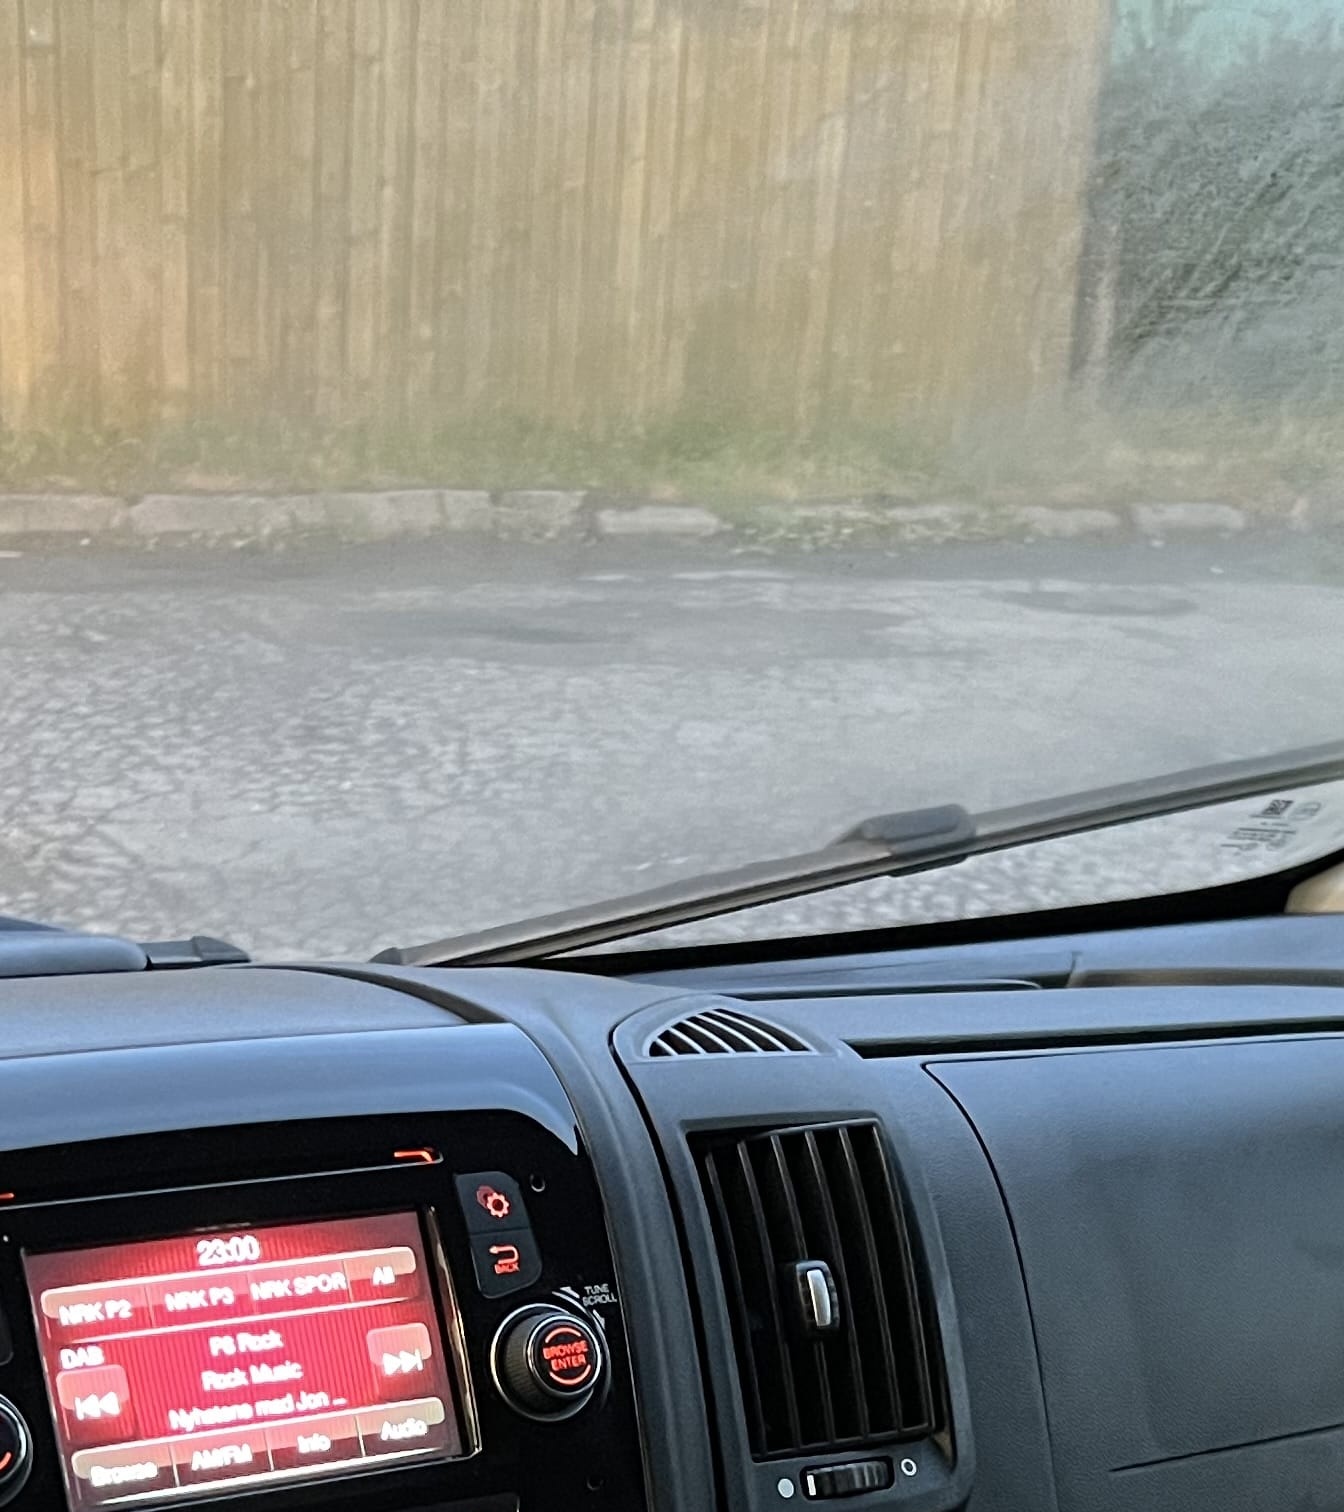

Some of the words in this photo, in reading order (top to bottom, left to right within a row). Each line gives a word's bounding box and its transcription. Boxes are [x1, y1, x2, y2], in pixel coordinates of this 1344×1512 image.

[196, 1235, 261, 1266] 23:00
[164, 1290, 208, 1312] NRK
[208, 1286, 235, 1306] P3
[250, 1279, 293, 1301] NRK
[293, 1272, 349, 1296] SPOR
[584, 1284, 610, 1295] TUNE
[58, 1302, 105, 1326] NRK
[105, 1299, 133, 1319] P2
[582, 1293, 617, 1307] SCROLL
[59, 1345, 105, 1370] DAB
[542, 1340, 589, 1360] BROWSE
[550, 1353, 587, 1371] ENTER
[249, 1360, 304, 1385] Music
[380, 1418, 428, 1441] Audio
